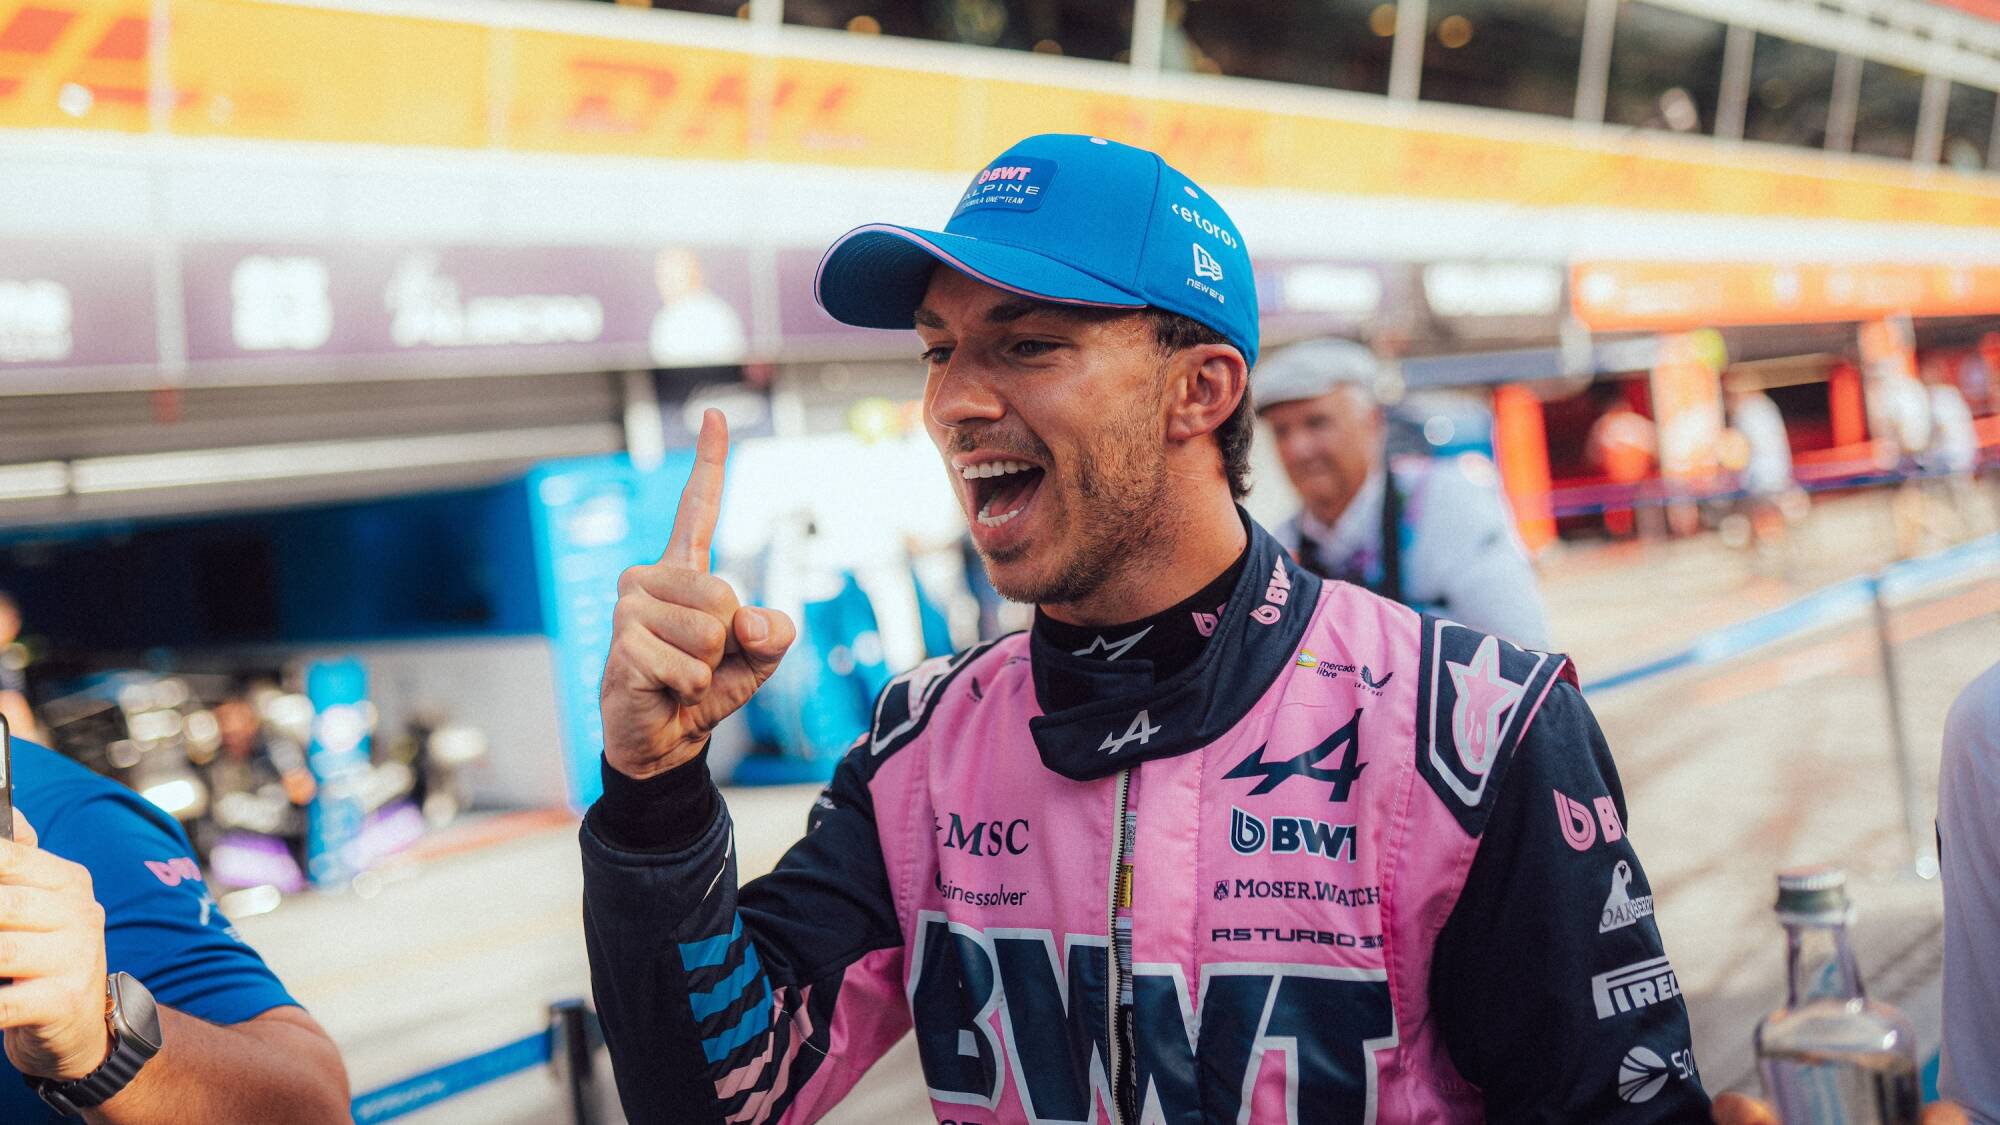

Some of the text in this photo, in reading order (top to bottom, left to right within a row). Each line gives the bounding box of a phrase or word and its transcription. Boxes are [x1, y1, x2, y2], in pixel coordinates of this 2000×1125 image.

[1316, 667, 1338, 679] libre
[1319, 660, 1356, 674] mercado
[944, 812, 1029, 857] MSC
[941, 879, 1027, 906] sinessolver
[1234, 878, 1381, 908] MOSER.WATCH
[906, 910, 1399, 1125] BWT
